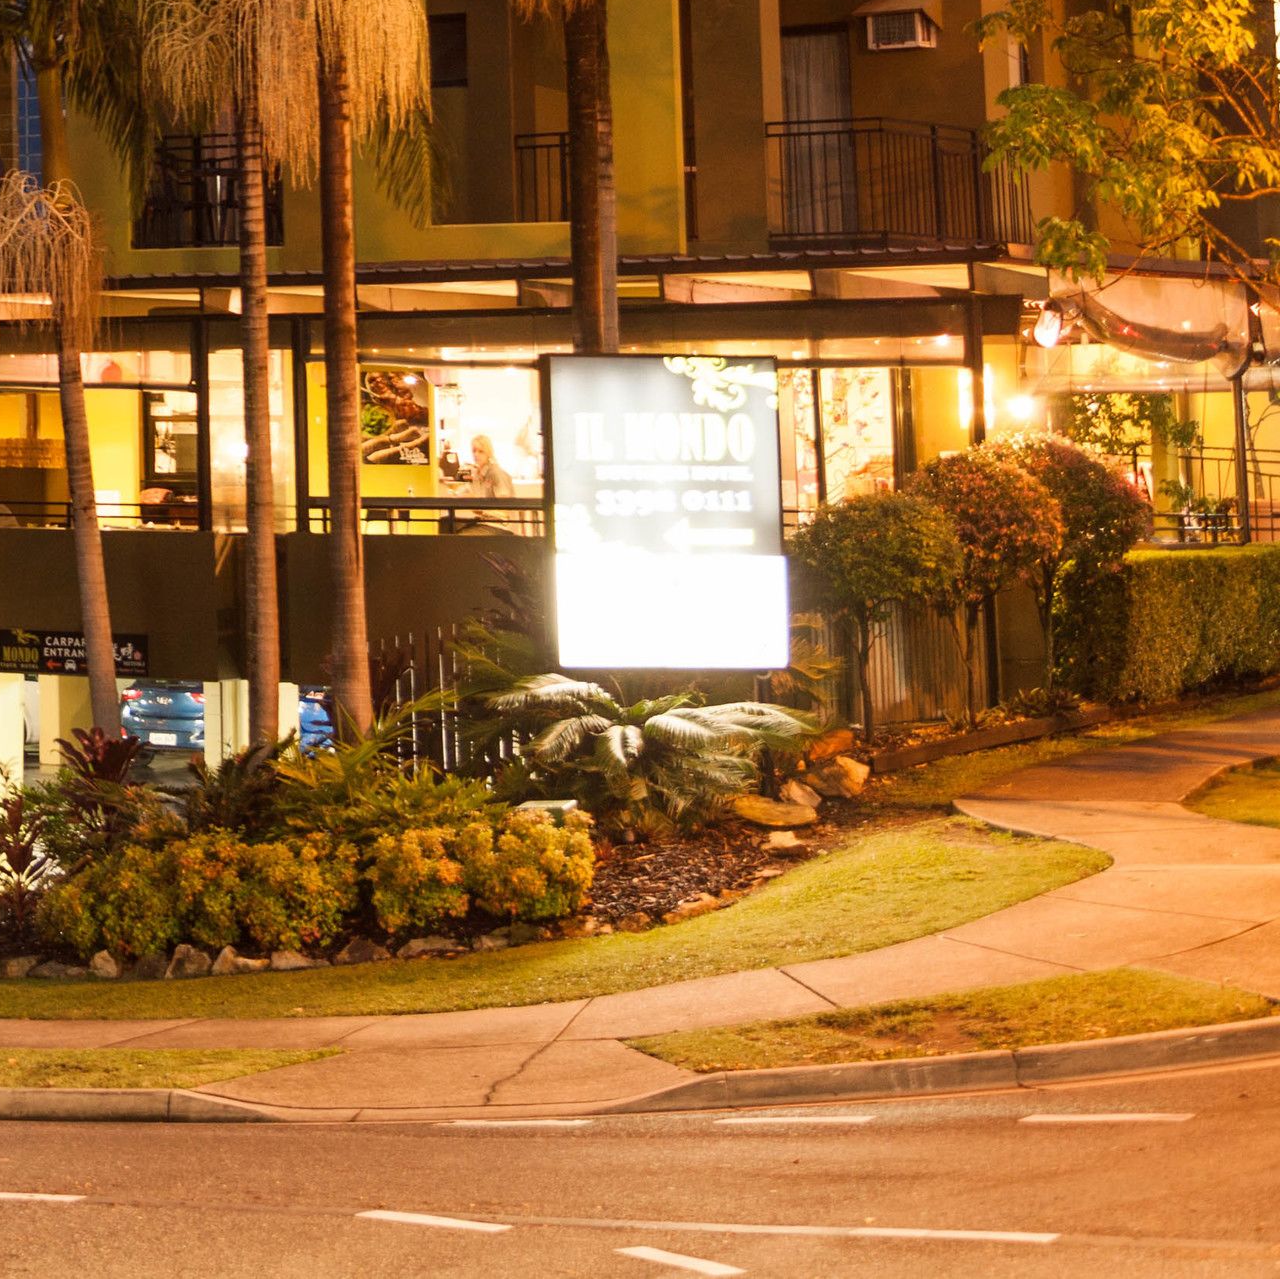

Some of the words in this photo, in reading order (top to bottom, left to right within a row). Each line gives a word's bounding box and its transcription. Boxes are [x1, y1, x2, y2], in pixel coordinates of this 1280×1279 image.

[574, 412, 614, 462] IL
[623, 412, 756, 462] MONDO
[45, 636, 87, 648] CARPAR
[3, 646, 39, 663] MONDO
[43, 647, 86, 658] ENTRAN
